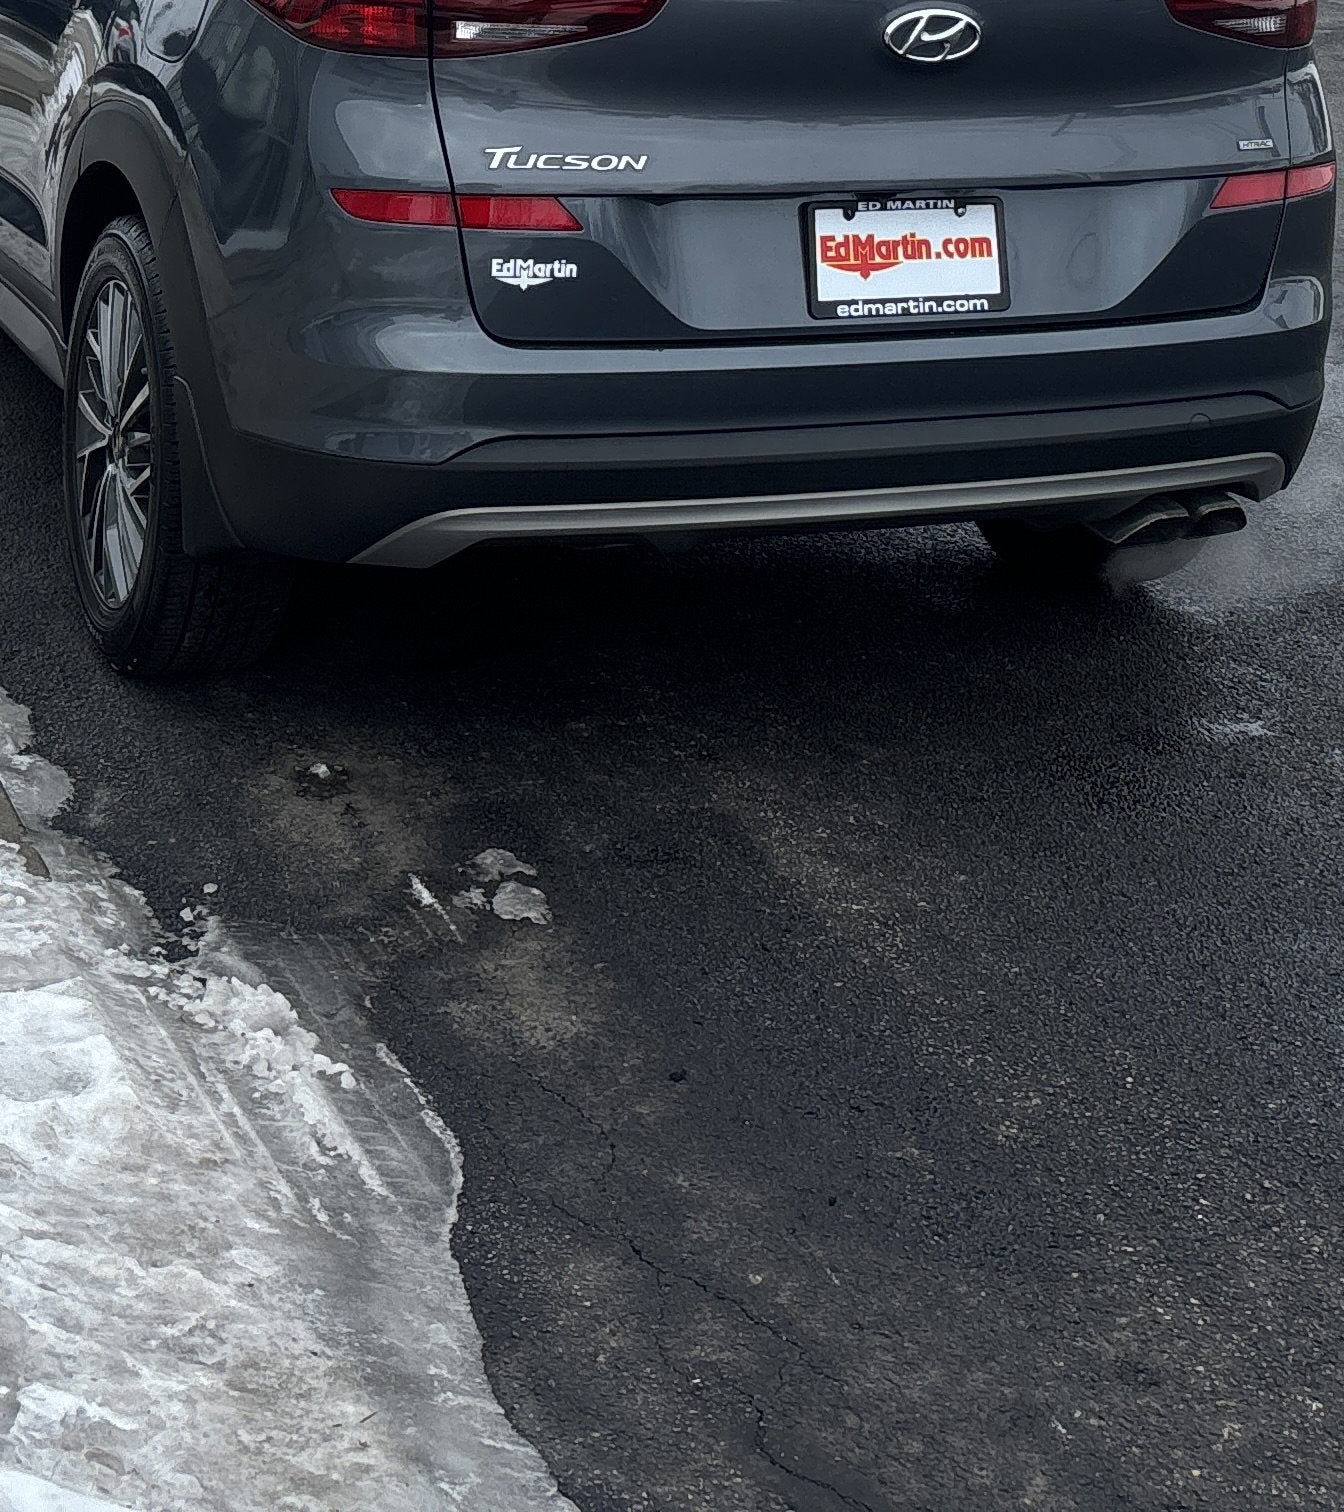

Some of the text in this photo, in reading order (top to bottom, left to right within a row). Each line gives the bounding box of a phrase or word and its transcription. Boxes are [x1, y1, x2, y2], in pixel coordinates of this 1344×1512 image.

[1242, 140, 1272, 148] HTRAC
[857, 199, 955, 211] ED MARTIN
[836, 298, 989, 318] edmartin.com
